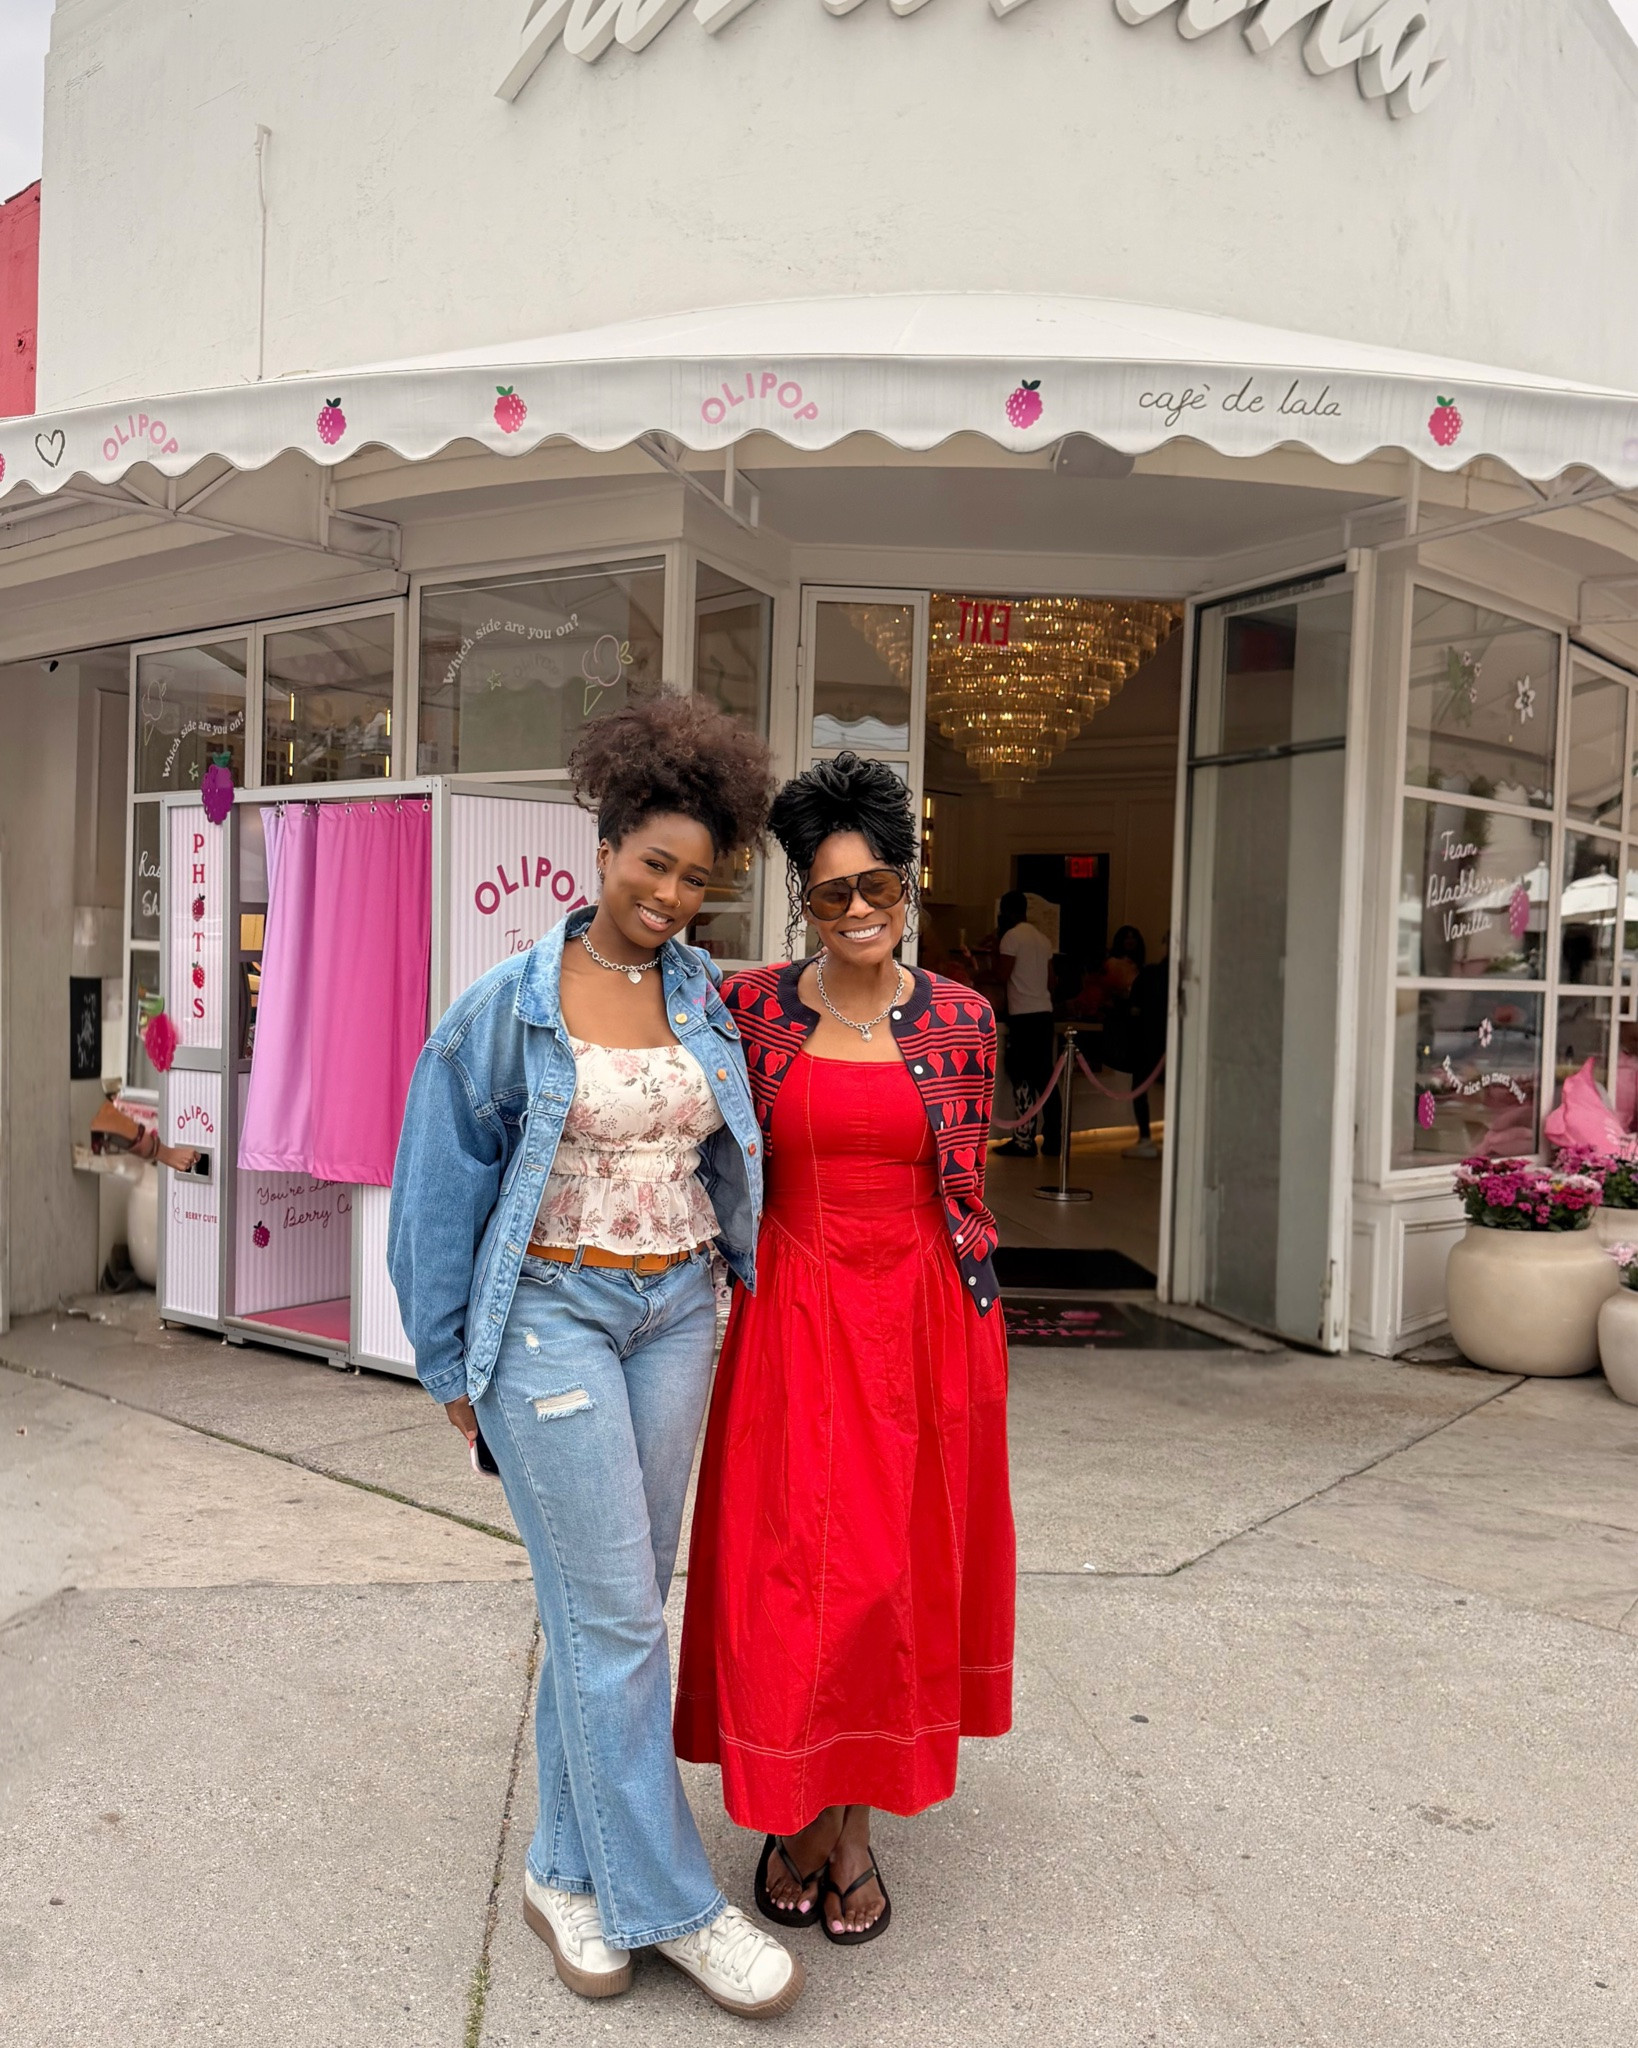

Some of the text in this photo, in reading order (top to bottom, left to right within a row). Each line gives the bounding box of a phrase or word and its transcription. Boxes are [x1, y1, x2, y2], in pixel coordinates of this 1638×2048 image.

[700, 372, 819, 424] OLIPOP
[1222, 376, 1265, 412] de
[1277, 379, 1342, 416] lala
[102, 413, 179, 461] OLIPOP
[443, 613, 580, 684] Which side are you on?
[162, 711, 244, 777] Which side are you on?
[1441, 830, 1478, 861] Team
[1443, 909, 1493, 942] Vanilla
[1481, 1074, 1491, 1087] to
[177, 1105, 214, 1133] OLIPOP
[257, 1180, 304, 1205] You're
[185, 1211, 218, 1224] BERRY CUTE
[283, 1207, 331, 1229] Berry
